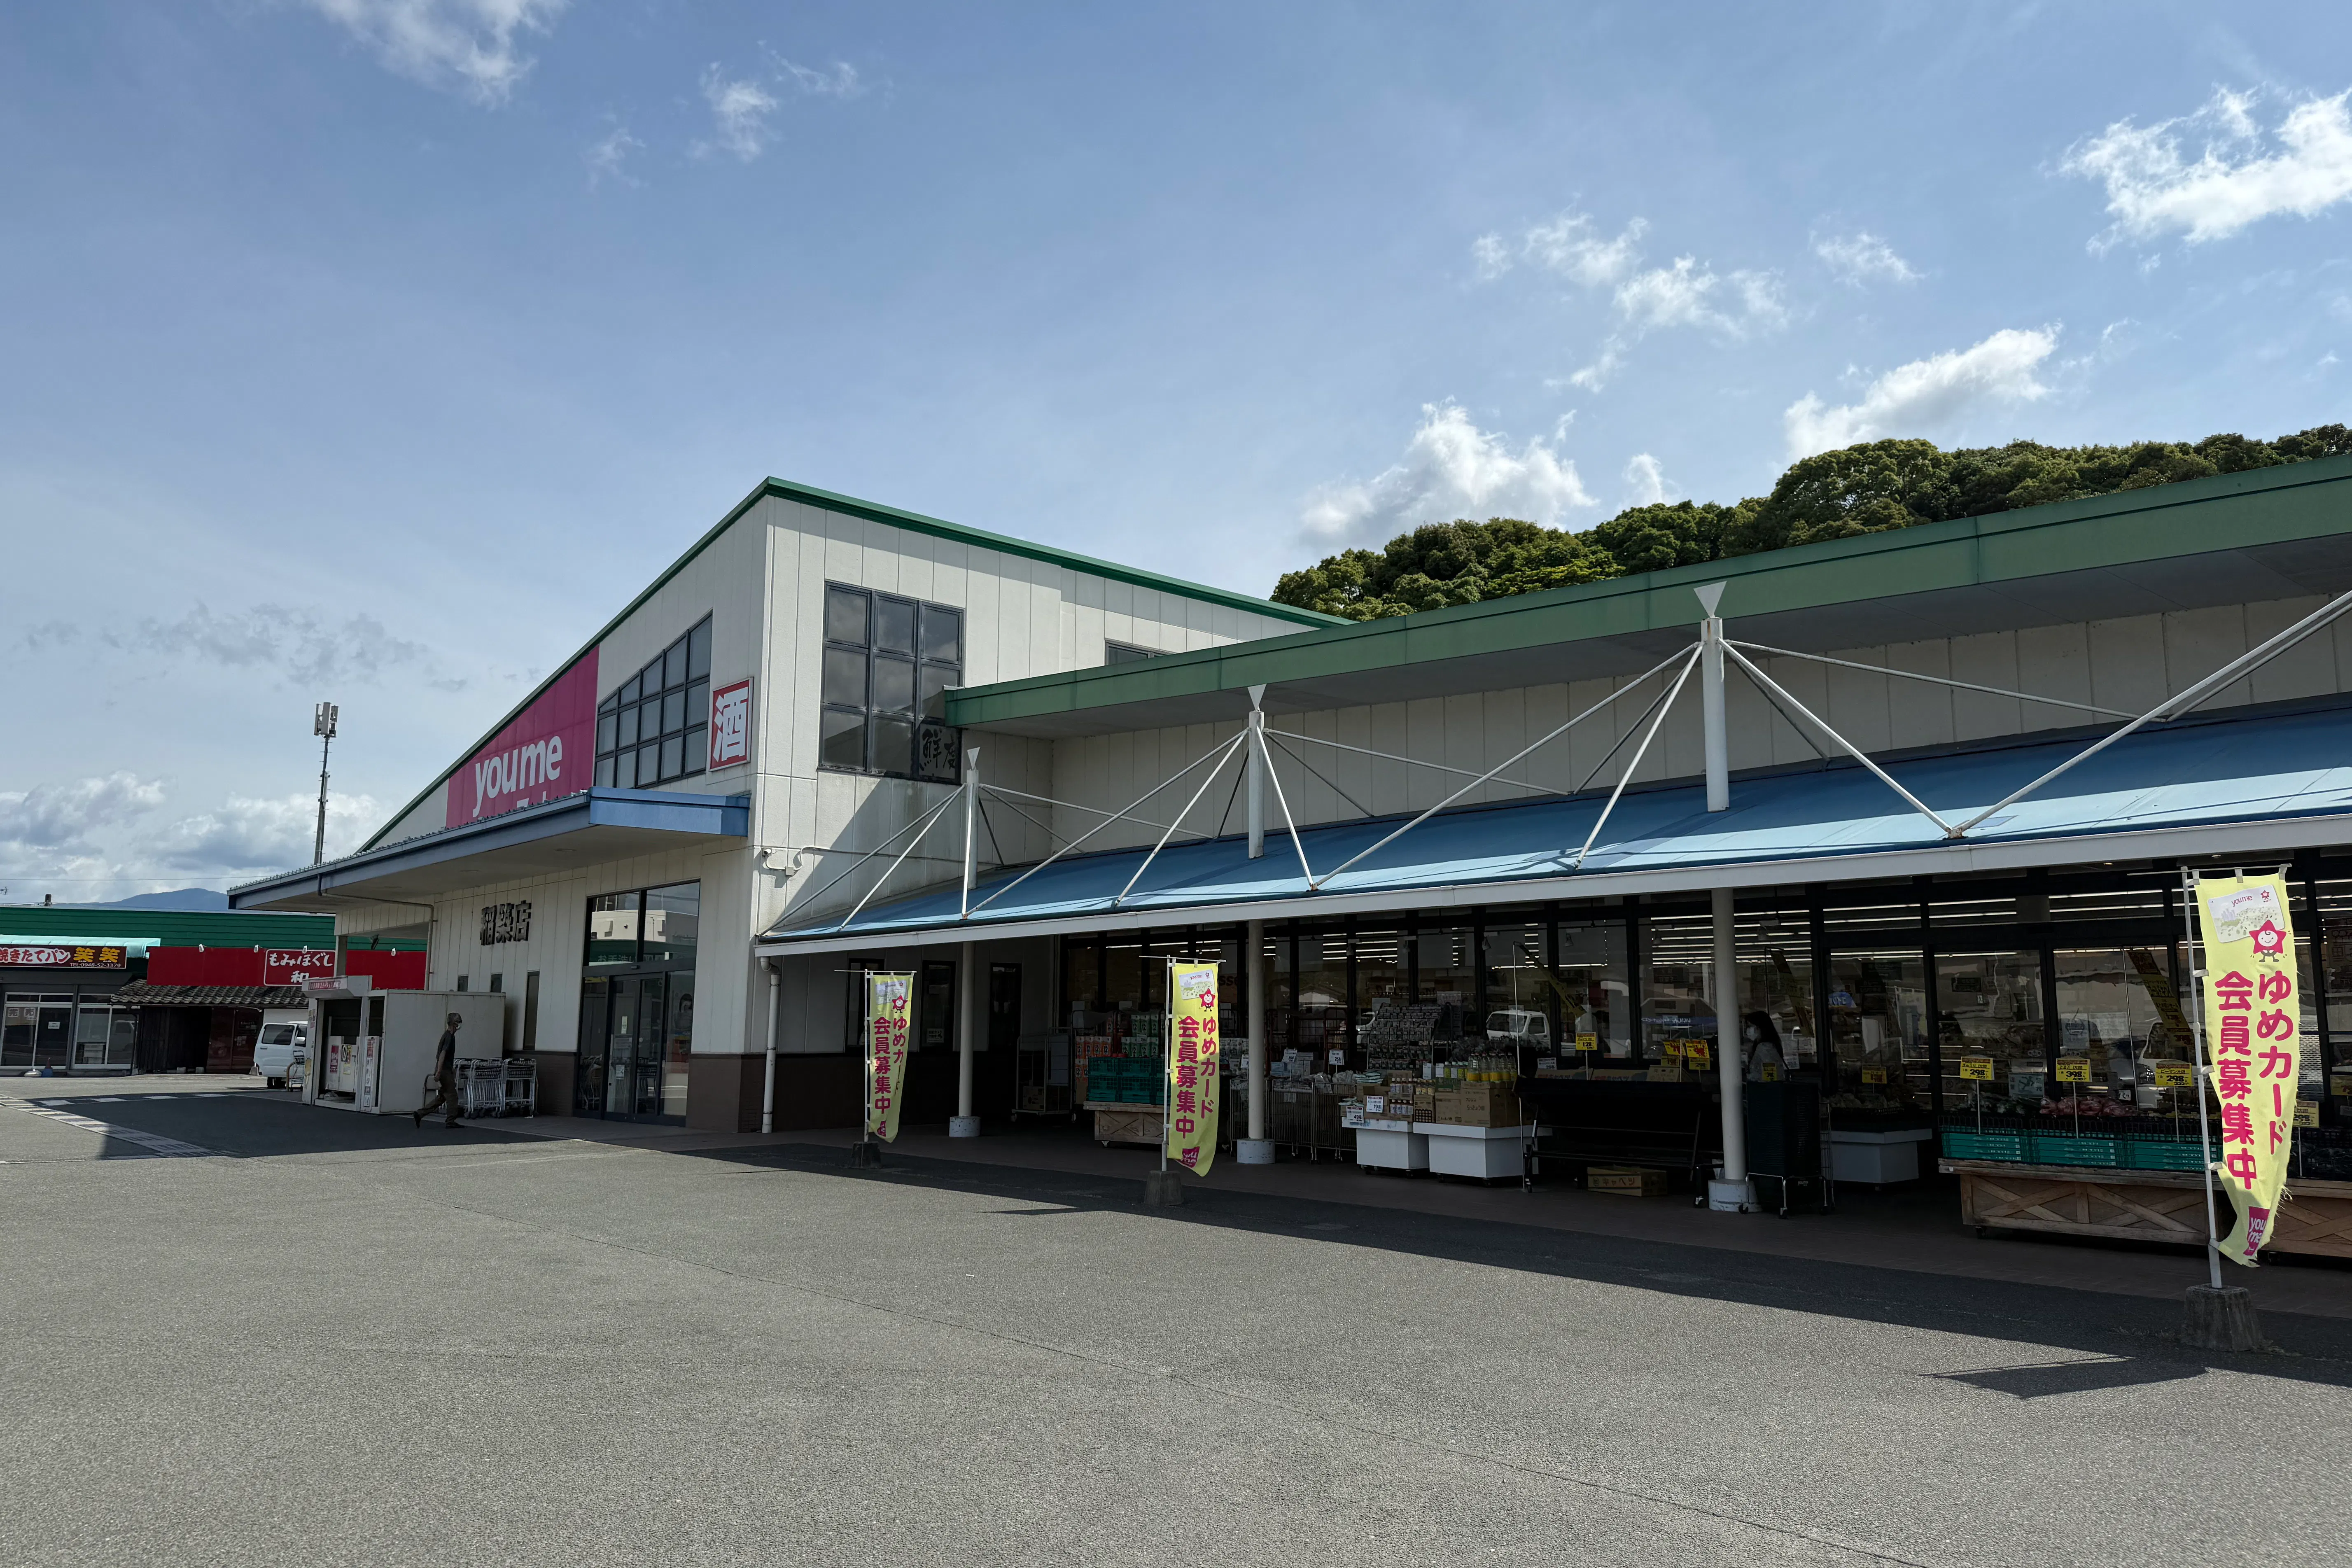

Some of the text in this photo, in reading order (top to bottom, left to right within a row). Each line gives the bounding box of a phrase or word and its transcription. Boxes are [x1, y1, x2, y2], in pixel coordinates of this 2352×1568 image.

[713, 686, 748, 762] 酒
[473, 736, 562, 817] youme
[2231, 895, 2253, 907] youme
[0, 949, 69, 963] 焼きたてパン
[269, 952, 333, 966] もみほぐし
[291, 971, 309, 983] 和
[874, 1016, 891, 1114] 会員募集中
[1175, 1015, 1200, 1139] 会員募集中
[1200, 1017, 1217, 1119] ゆめカード
[2215, 971, 2257, 1190] 会員募集中
[2257, 970, 2294, 1155] ゆめカード
[1602, 1177, 1635, 1186] キャベツ
[2250, 1217, 2267, 1232] you
